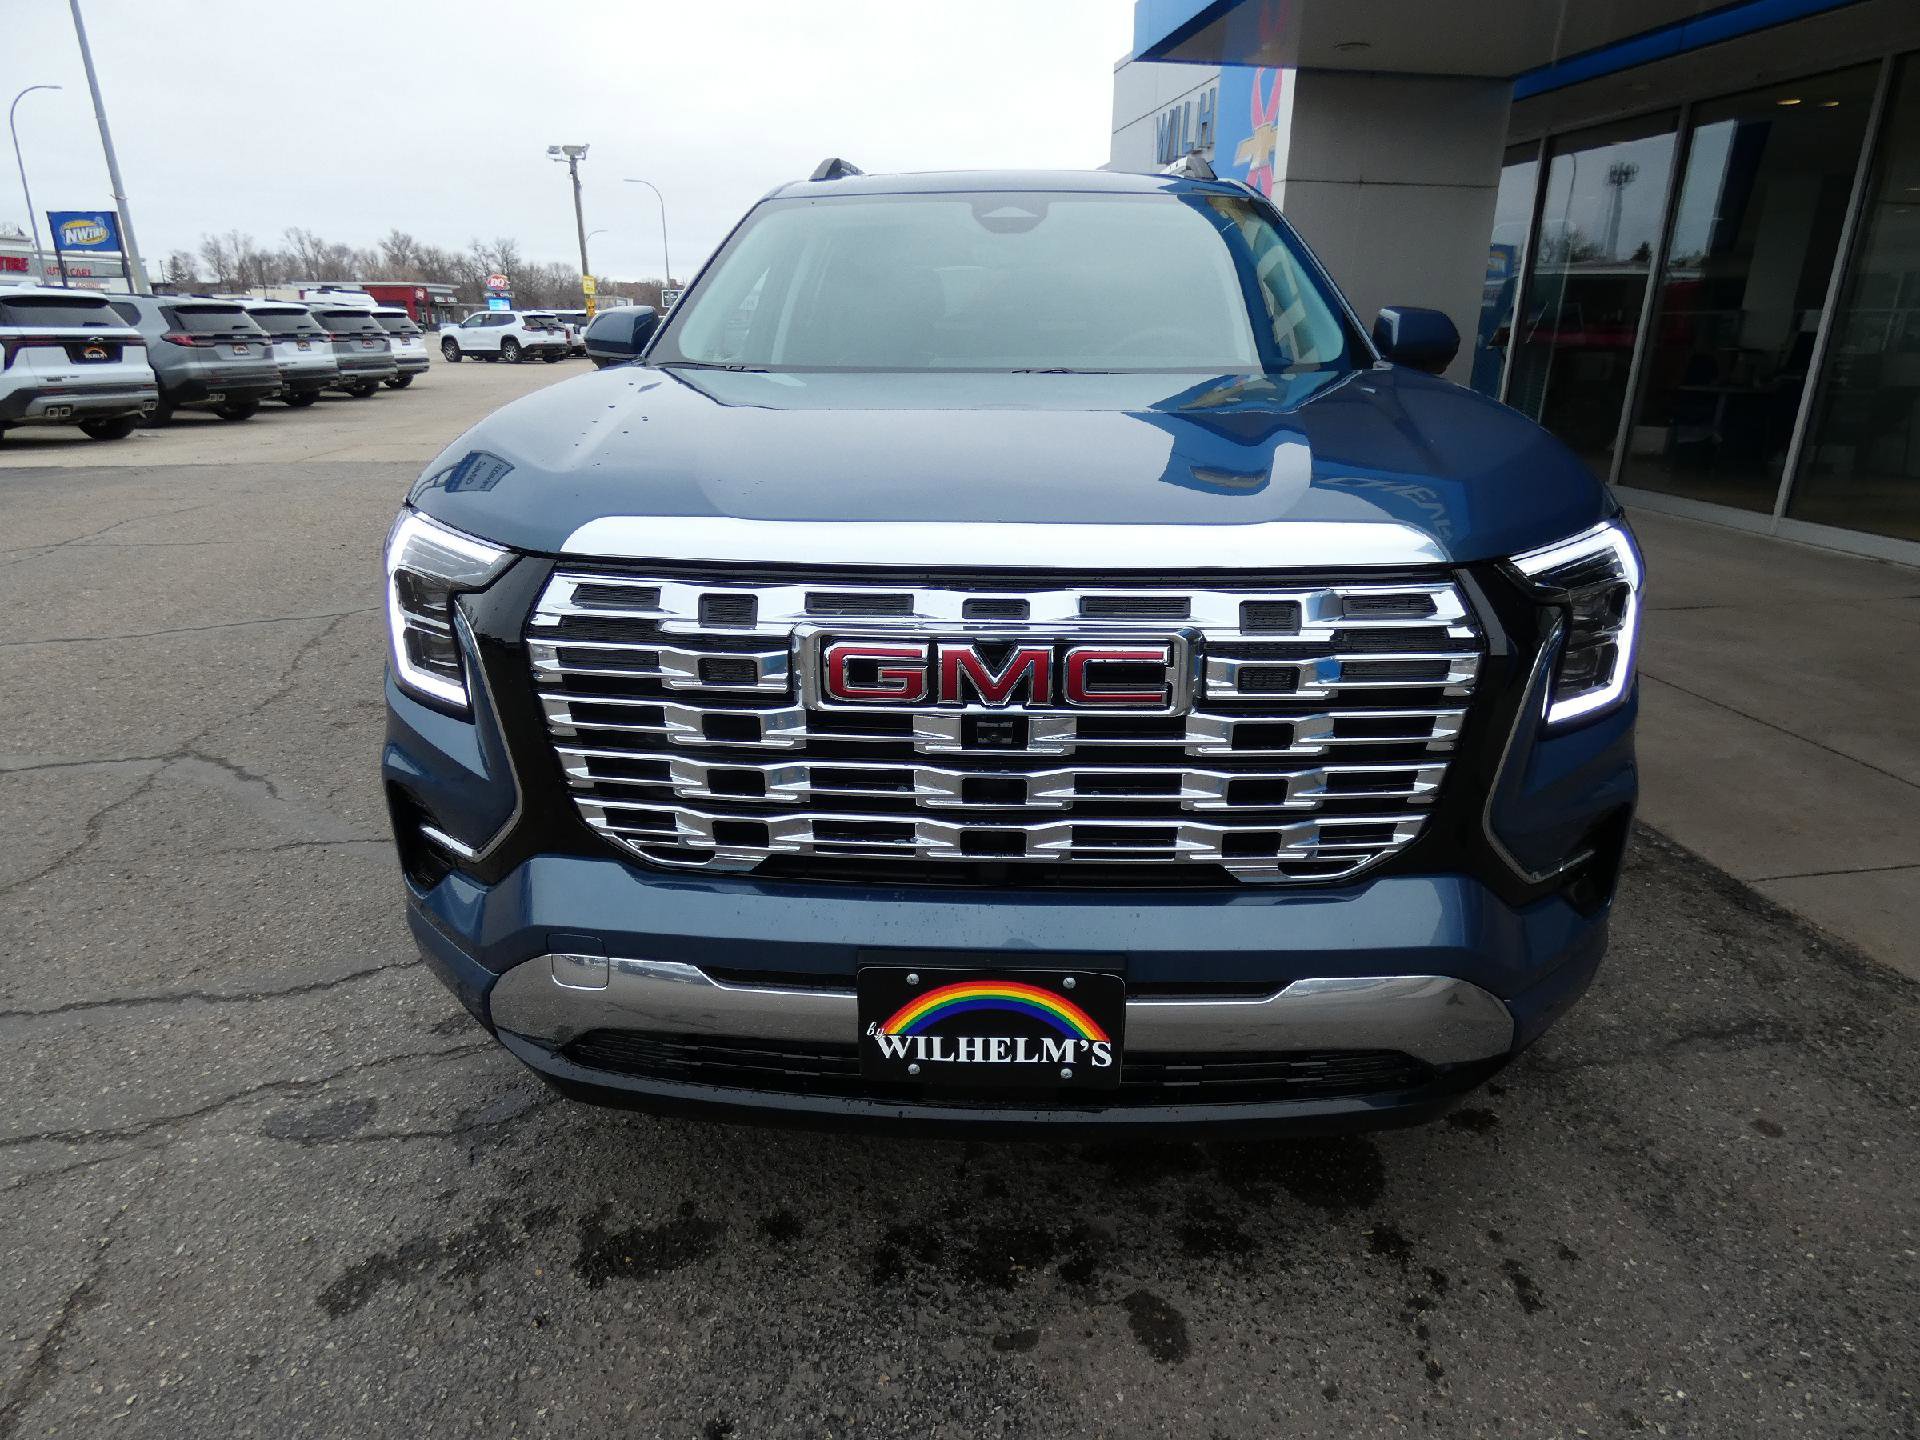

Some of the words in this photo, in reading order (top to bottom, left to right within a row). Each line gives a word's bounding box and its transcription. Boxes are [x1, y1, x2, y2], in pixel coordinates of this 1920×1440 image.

[824, 641, 1170, 707] GMC
[866, 1021, 886, 1039] by
[877, 1034, 1113, 1067] WILHELM'S
